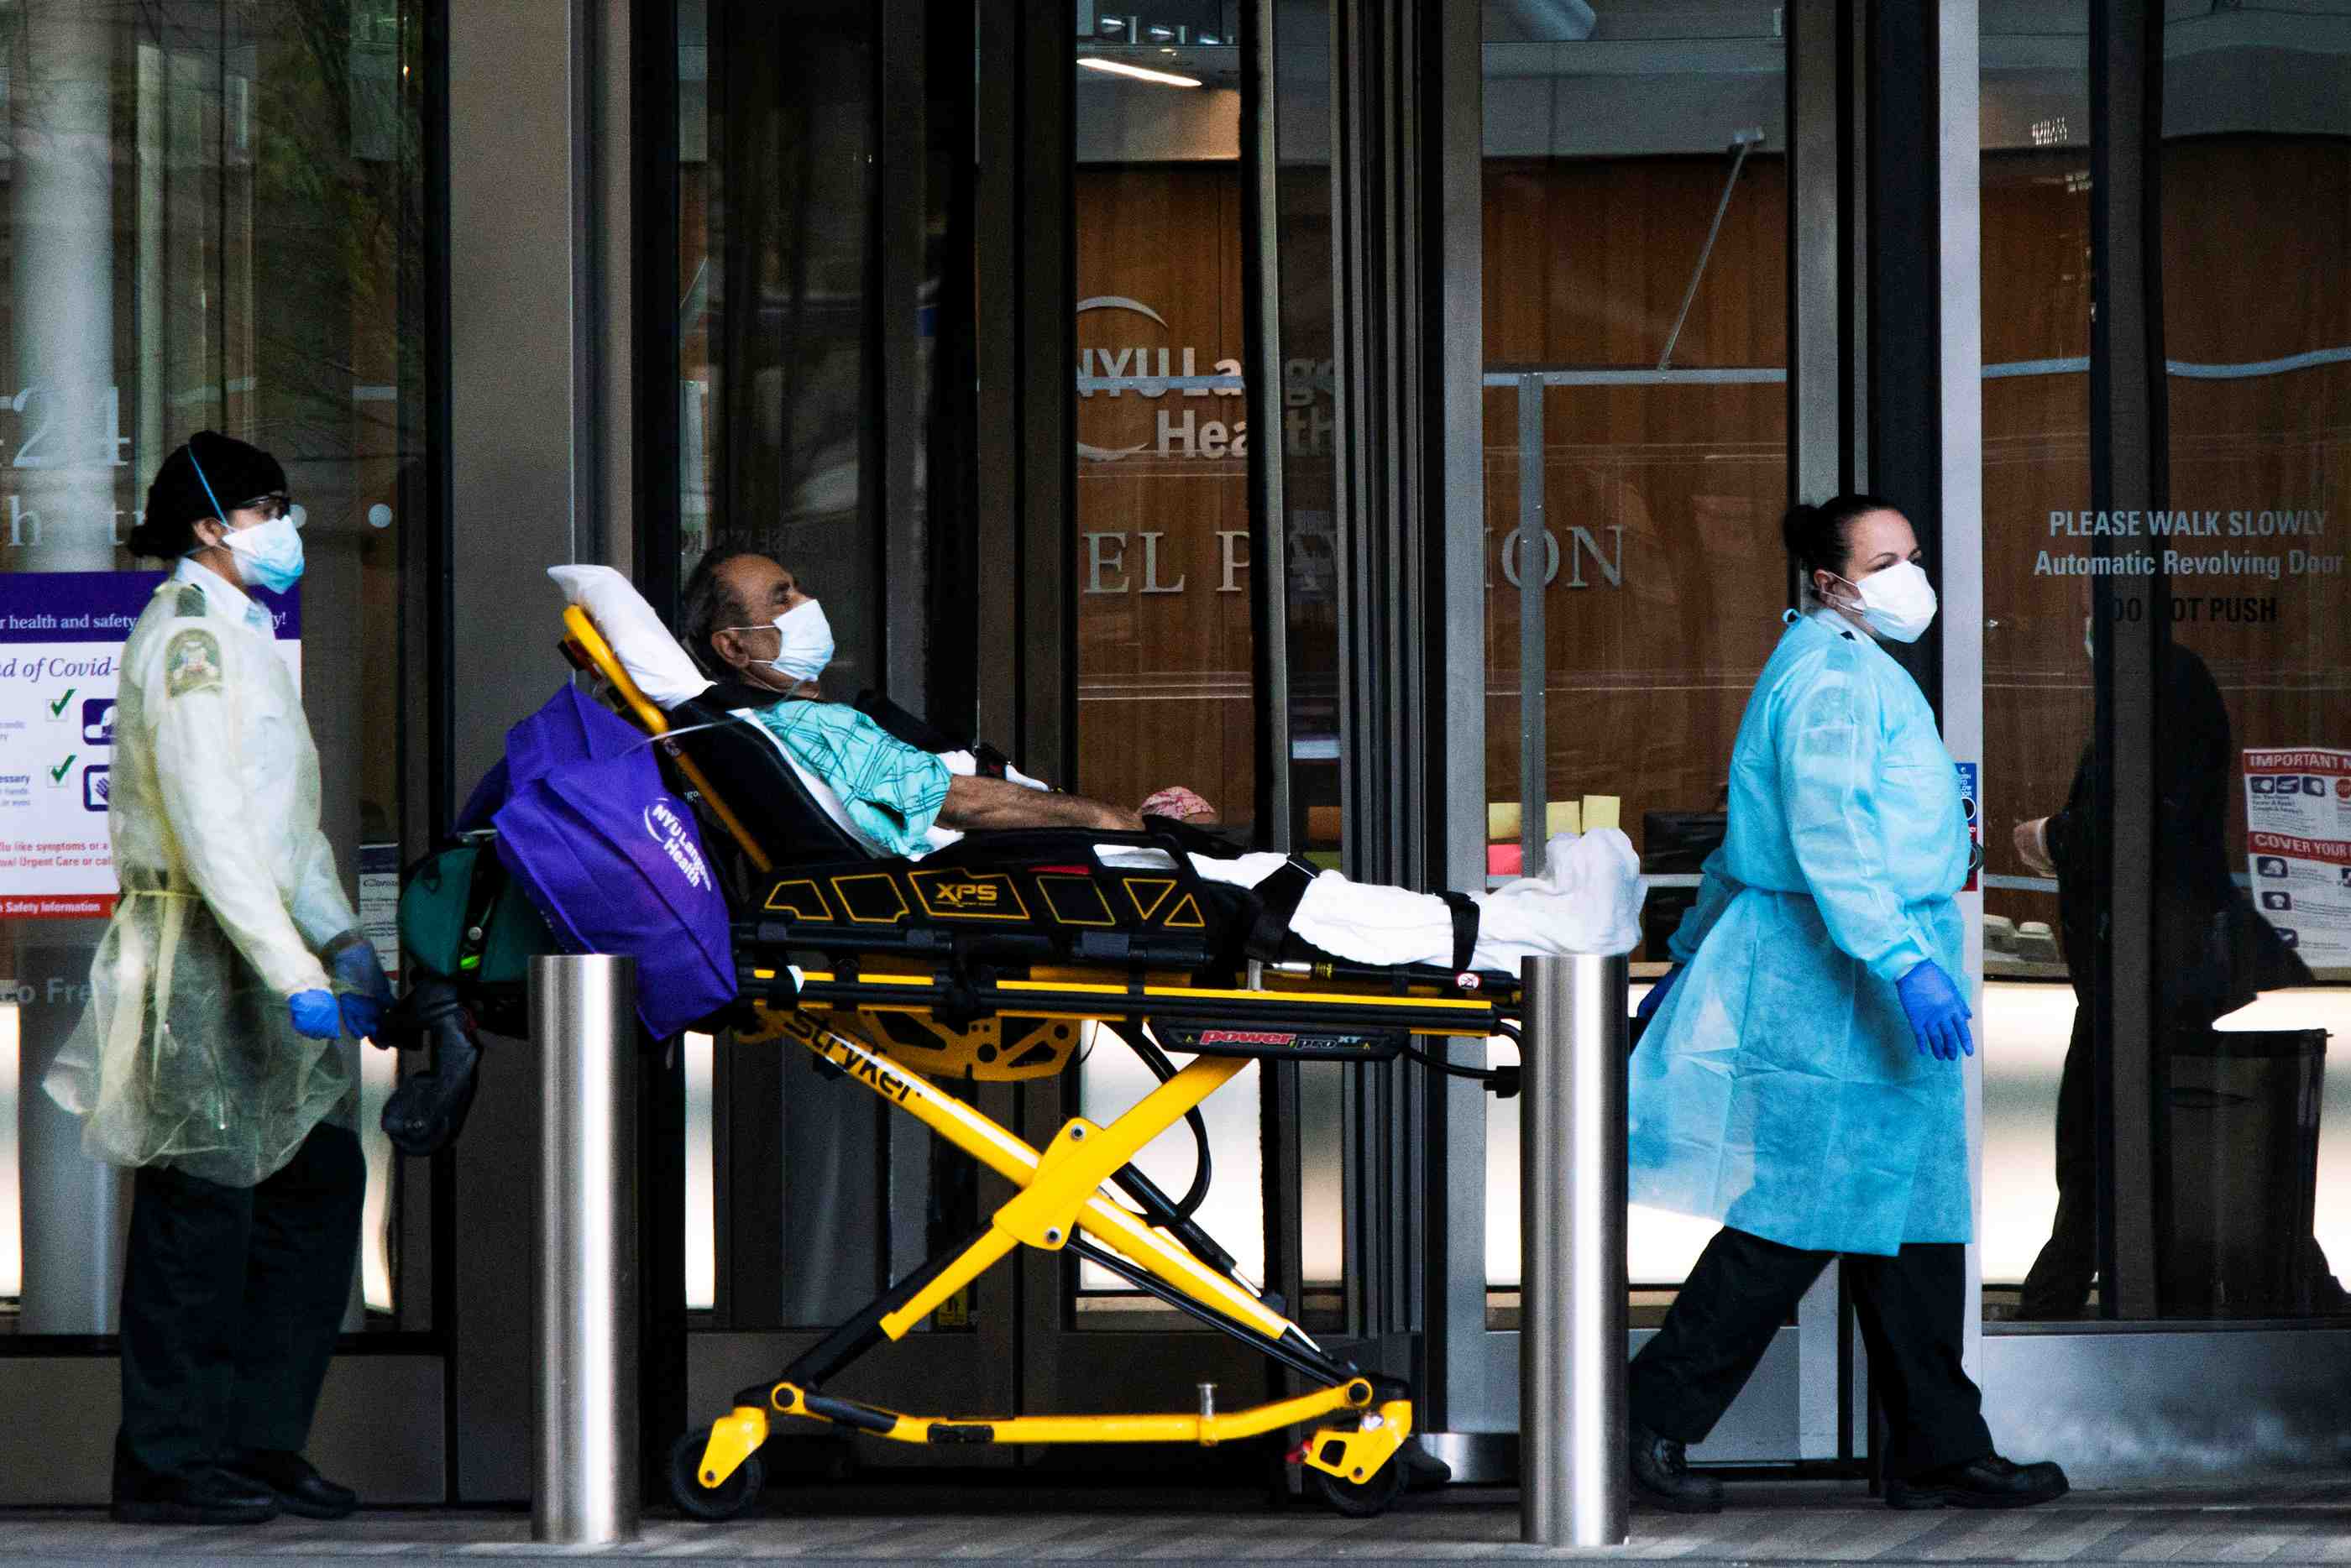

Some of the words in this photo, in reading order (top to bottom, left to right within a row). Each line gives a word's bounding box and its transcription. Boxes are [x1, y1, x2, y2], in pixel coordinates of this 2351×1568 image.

[2050, 510, 2140, 537] PLEASE
[2146, 510, 2220, 537] WALK
[2228, 510, 2327, 537] SLOWLY
[2034, 550, 2155, 577] Automatic
[2163, 550, 2280, 580] Revolving
[2288, 550, 2344, 576] Door
[2209, 597, 2277, 622] PUSH
[9, 614, 57, 629] health
[60, 614, 89, 628] and
[23, 656, 46, 683] of
[2250, 753, 2338, 769] IMPORTANT
[652, 804, 682, 836] NYU
[36, 842, 86, 854] symptoms
[2255, 834, 2312, 854] COVER
[2314, 842, 2348, 857] YOUR
[19, 857, 54, 868] Urgent
[55, 856, 80, 866] Care
[663, 838, 700, 887] Health
[935, 883, 997, 902] XPS
[6, 902, 39, 914] Safety
[40, 901, 101, 913] Information
[1200, 1030, 1296, 1045] power
[783, 1007, 911, 1102] stryker
